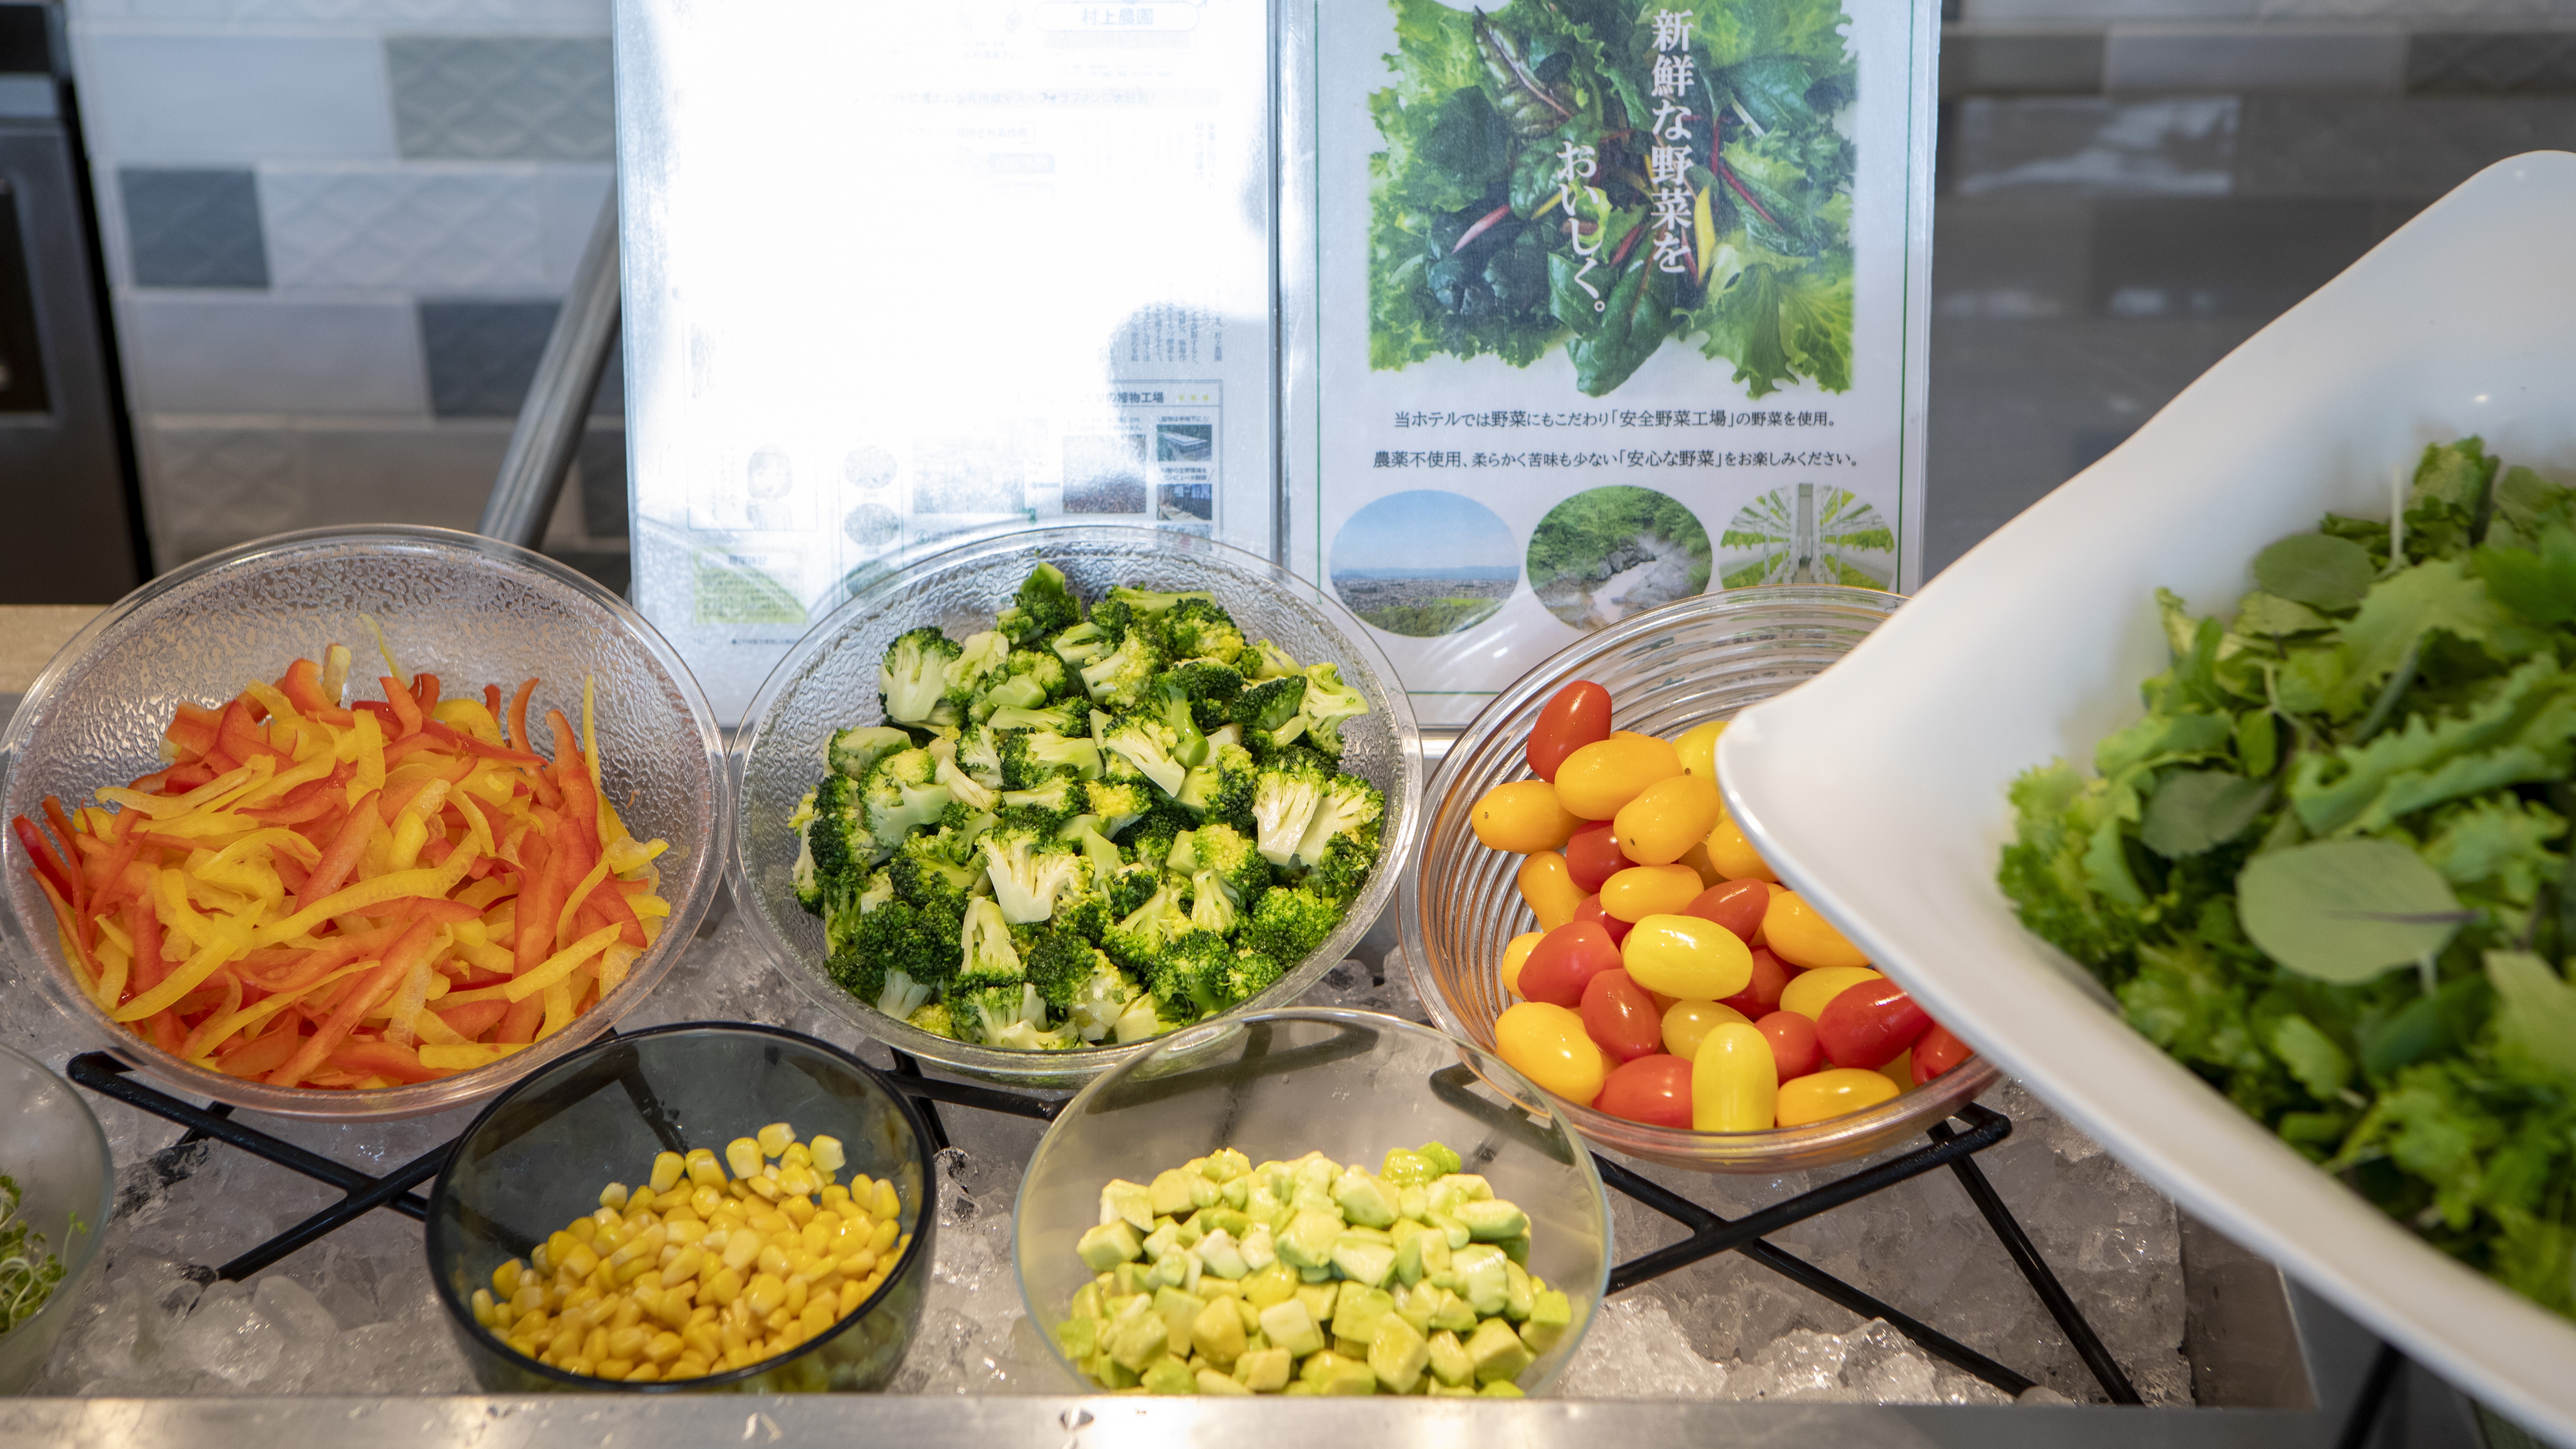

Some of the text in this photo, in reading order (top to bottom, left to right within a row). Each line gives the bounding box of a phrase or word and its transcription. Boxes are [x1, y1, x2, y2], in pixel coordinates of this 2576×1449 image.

[1651, 9, 1694, 273] 新鮮な野菜を
[1556, 140, 1605, 312] おいしく。
[1373, 449, 1857, 468] 農薬不使用、柔らかく苦味も少ない「安心な野菜」をお楽しみください。
[1395, 409, 1834, 428] 当ホテルでは野菜にもこだわり「安全野菜工場」の野菜を使用。
